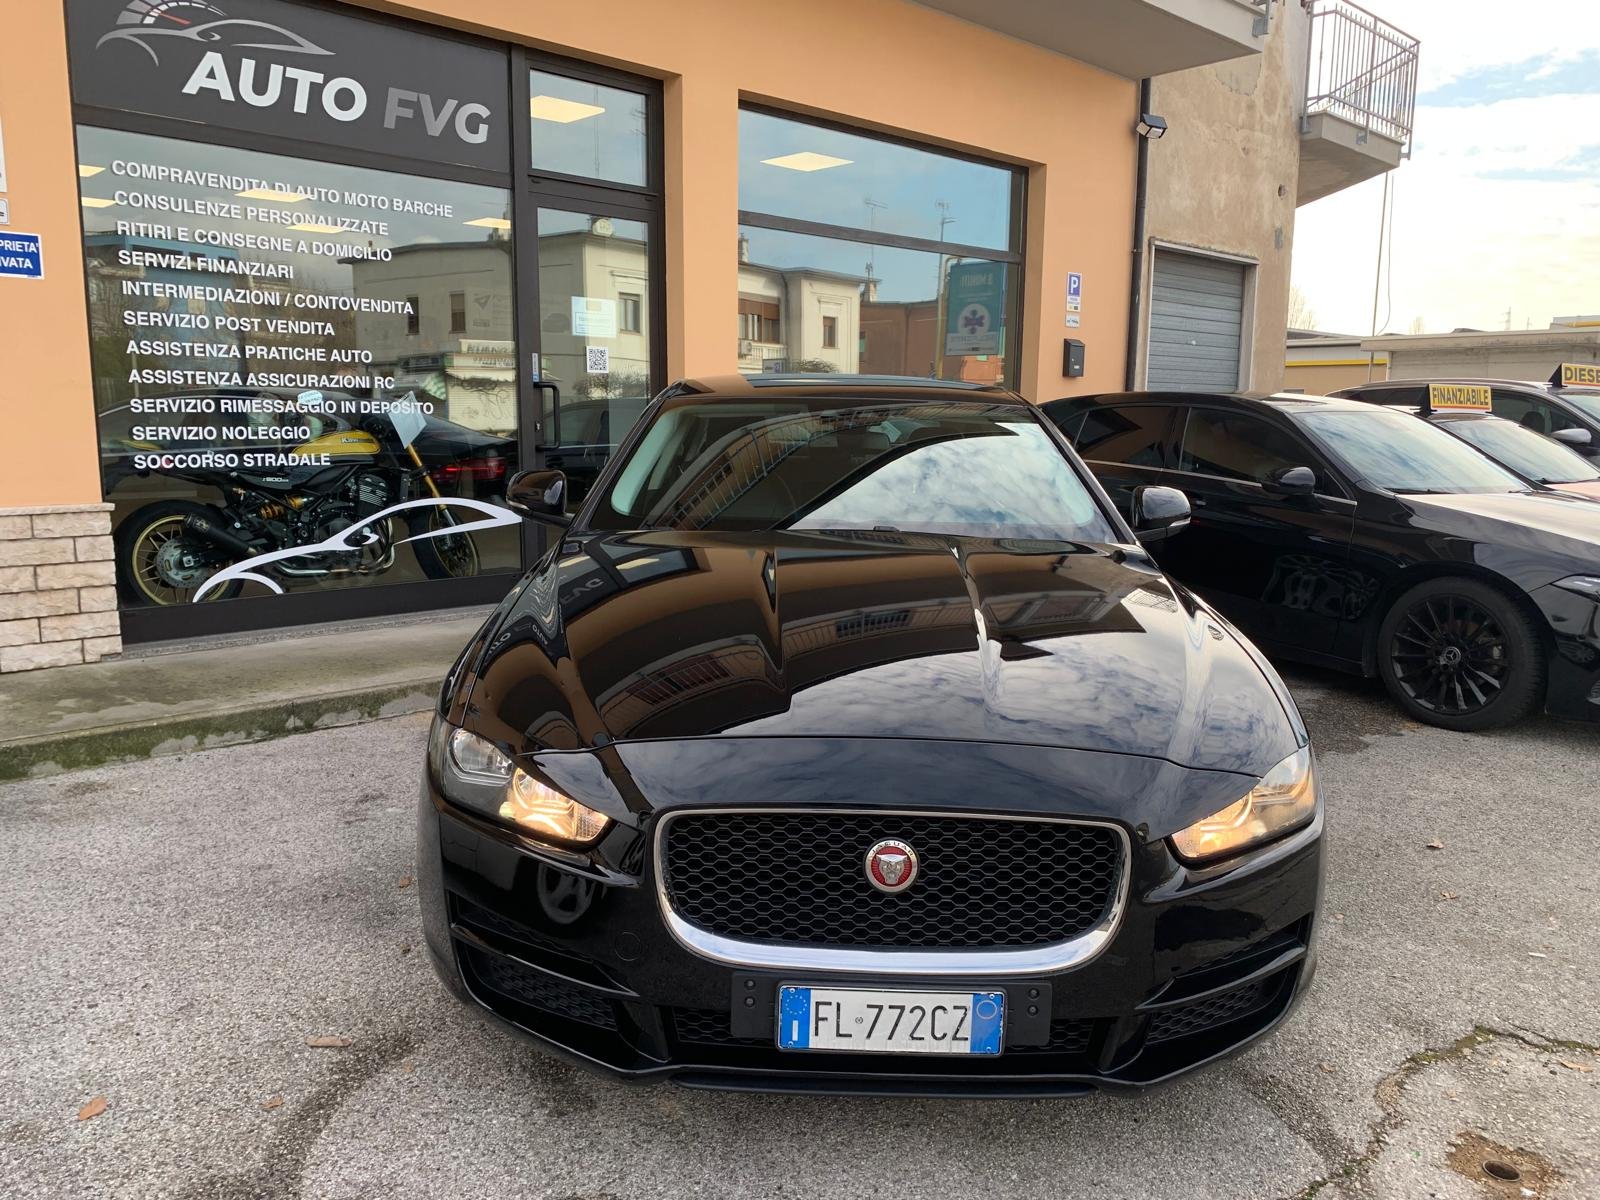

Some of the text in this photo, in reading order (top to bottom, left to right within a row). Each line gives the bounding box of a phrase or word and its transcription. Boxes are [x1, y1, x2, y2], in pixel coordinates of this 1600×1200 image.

[181, 50, 492, 144] AUTO FVG
[112, 160, 453, 218] COMPRAVENDITA DI AUTO MOTO BARCHE
[114, 190, 389, 236] CONSULENZE PERSONALIZZATE
[116, 220, 392, 262] RITIRI E CONSEGNE A DOMICILIO
[118, 250, 294, 279] SERVIZI FINANZIARI
[122, 280, 414, 315] INTERMEDIAZIONI / CONTOVENDITA
[1070, 276, 1079, 294] P
[123, 310, 335, 336] SERVIZIO POST VENDITA
[126, 340, 373, 363] ASSISTENZA PRATICHE AUTO
[128, 369, 395, 389] ASSISTENZA ASSICURAZIONI RC
[130, 398, 434, 415] SERVIZIO RIMESSAGGIO IN DEPOSITO
[1432, 387, 1489, 406] FINANZIABILE
[132, 426, 311, 441] SERVIZIO NOLEGGIO
[134, 453, 331, 469] SOCCORSO STRADALE
[865, 1003, 970, 1042] 772CZ
